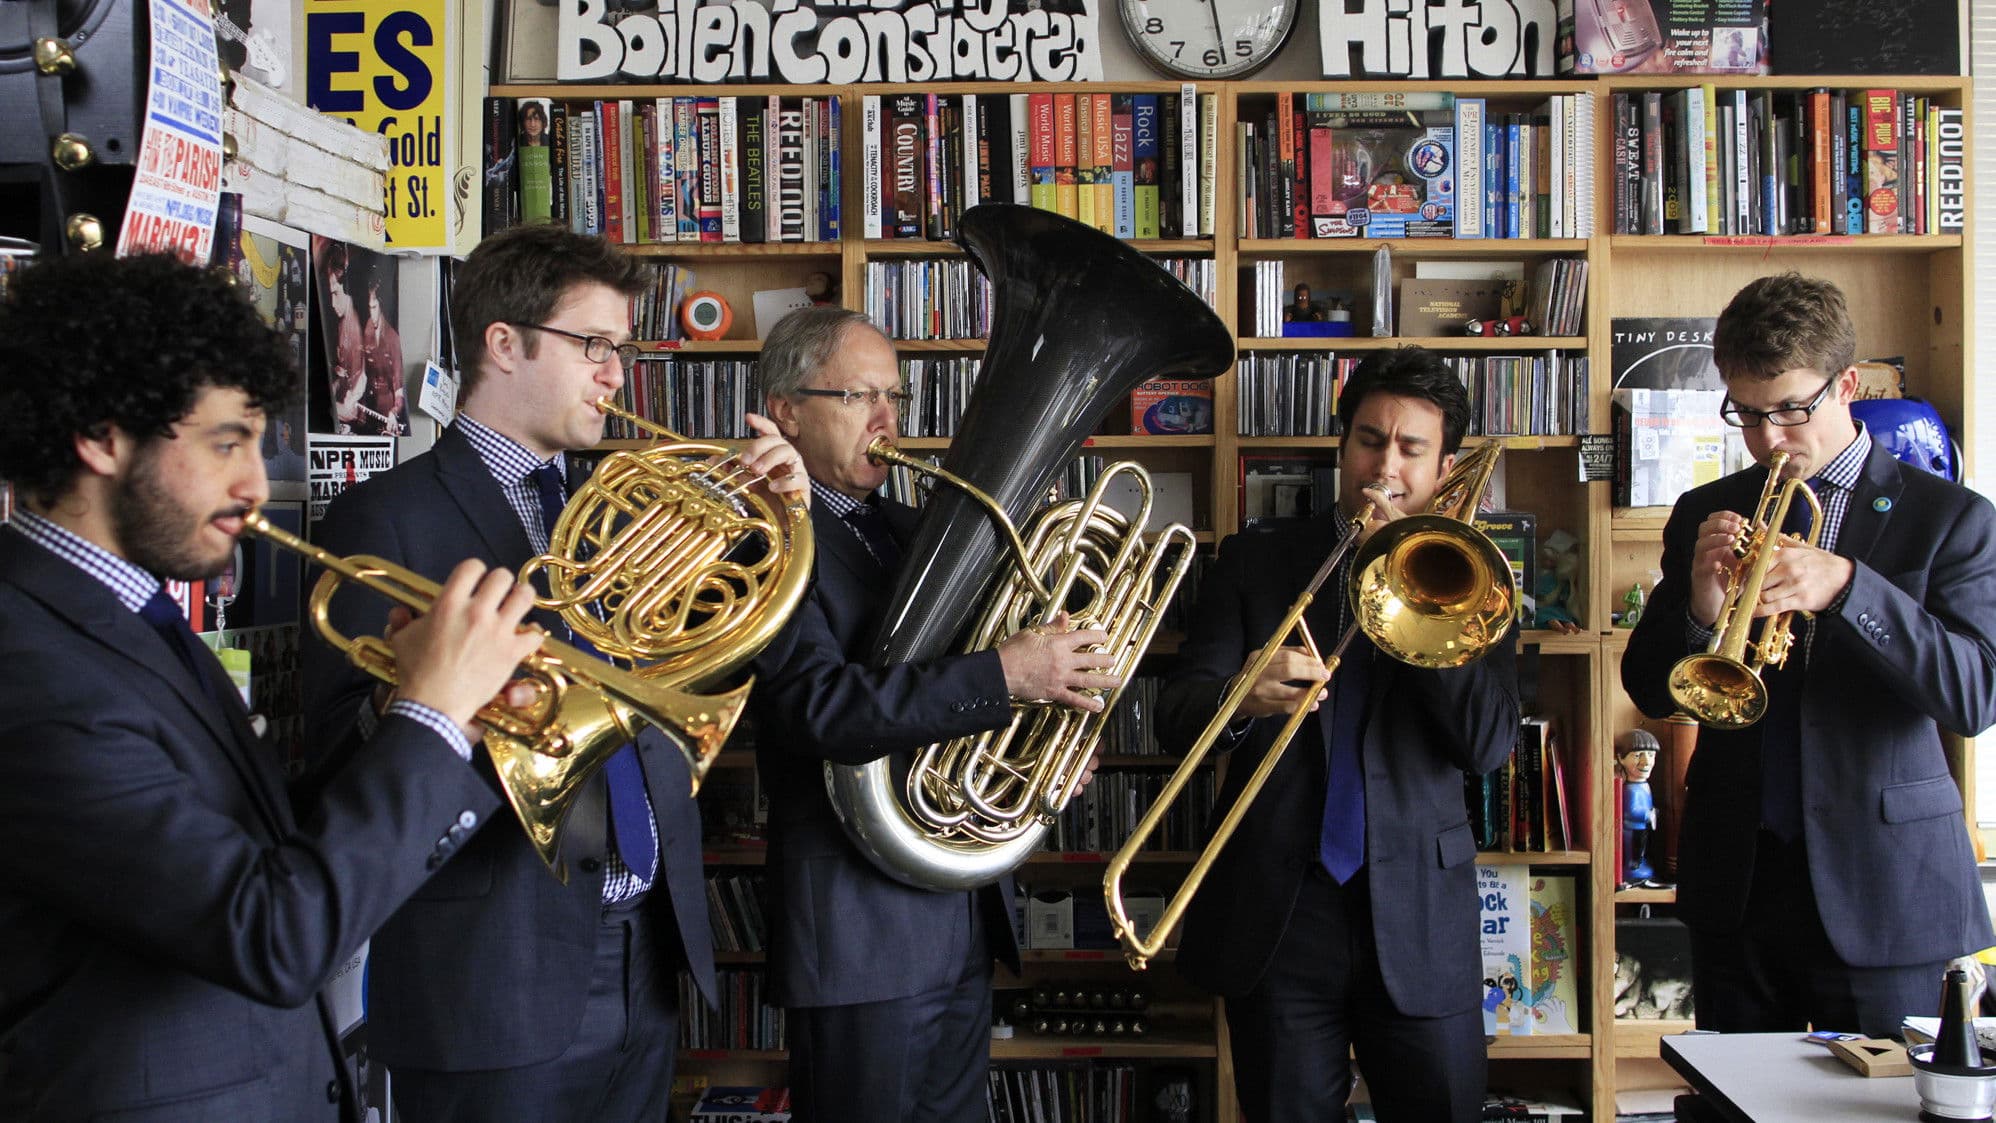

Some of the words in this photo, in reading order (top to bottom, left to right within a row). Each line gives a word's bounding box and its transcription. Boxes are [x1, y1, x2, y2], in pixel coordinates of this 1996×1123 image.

[1145, 17, 1164, 34] 8
[1671, 29, 1690, 37] Wake
[1691, 31, 1701, 39] up
[557, 0, 771, 82] Boilen
[1170, 41, 1186, 58] 7
[1235, 40, 1254, 57] 5
[1664, 49, 1676, 58] fire
[307, 11, 434, 112] ES
[1202, 50, 1220, 66] 6
[1674, 59, 1708, 67] refreshed!
[1041, 104, 1050, 132] World
[1063, 104, 1072, 132] World
[1081, 96, 1090, 134] Classical
[1096, 100, 1107, 132] Music
[1850, 108, 1858, 122] BEST
[1870, 96, 1890, 113] BIG
[678, 106, 688, 136] NUMBER
[746, 115, 760, 143] THE
[1138, 106, 1154, 148] Rock
[1850, 124, 1858, 143] MUSIC
[1874, 123, 1891, 144] PULPS
[1939, 110, 1964, 157] LOU
[377, 115, 441, 168] Gold
[662, 140, 673, 160] TOP
[701, 116, 711, 162] ALBUM
[710, 117, 718, 164] ROLLING
[780, 111, 803, 180] REED
[1018, 130, 1028, 148] jimi
[1042, 134, 1051, 162] Music
[1064, 135, 1073, 162] Music
[1082, 137, 1090, 160] music
[1098, 136, 1108, 159] USA
[1114, 124, 1131, 162] Jazz
[1616, 138, 1626, 165] CASH
[173, 138, 220, 192] PARISH
[555, 148, 566, 164] Fire
[870, 150, 878, 176] TENACITY
[897, 123, 918, 193] COUNTRY
[979, 140, 990, 171] JIMMY
[1628, 128, 1640, 180] SWEAT
[662, 162, 674, 177] 40
[702, 164, 712, 202] GUIDE
[748, 148, 761, 210] BEATLES
[1020, 152, 1029, 188] hendrix
[407, 175, 436, 219] St.
[662, 180, 674, 216] ALBUMS
[710, 167, 720, 203] STONE
[870, 182, 878, 216] COCKROACH
[980, 174, 991, 198] PAGE
[1470, 166, 1478, 226] ENCYCLOPEDIA
[1939, 164, 1964, 227] REED
[1668, 187, 1676, 218] 2009
[121, 211, 181, 257] MARCH
[1614, 332, 1656, 343] TINY
[1666, 331, 1714, 342] DESK
[1136, 382, 1179, 391] ROBOT
[1181, 382, 1209, 391] DOG
[310, 450, 356, 470] NPR
[360, 450, 391, 469] MUSIC
[1594, 454, 1613, 464] 24/7
[1478, 881, 1486, 890] to
[1500, 882, 1506, 890] a
[1480, 868, 1498, 879] You
